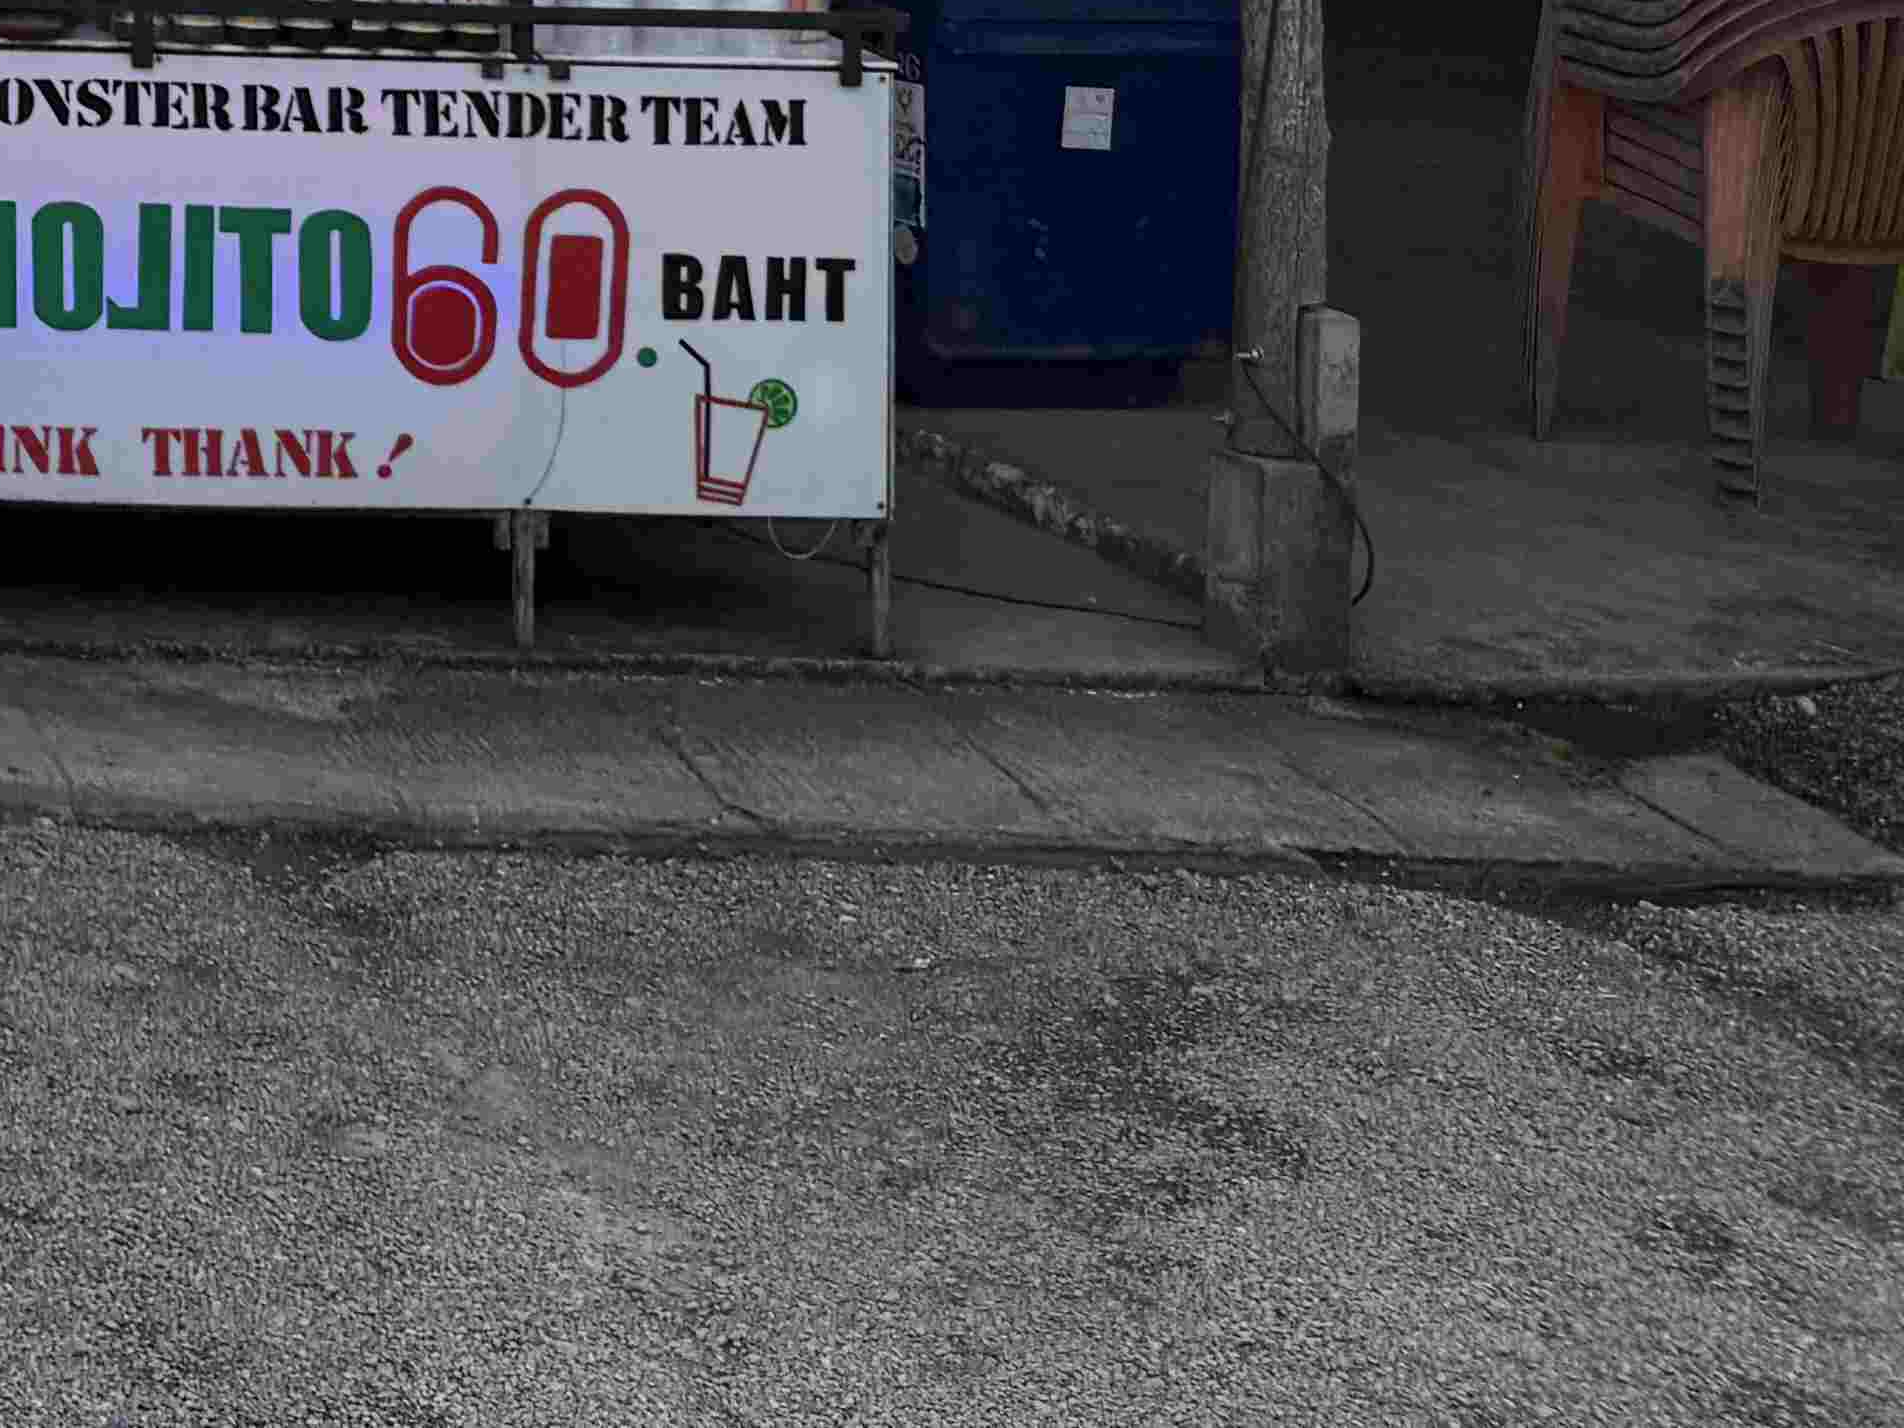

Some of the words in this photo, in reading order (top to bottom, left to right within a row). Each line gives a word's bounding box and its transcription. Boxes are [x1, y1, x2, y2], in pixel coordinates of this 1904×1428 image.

[241, 83, 369, 135] BAR
[381, 88, 630, 142] TENDER
[640, 95, 808, 146] TEAM
[661, 251, 857, 323] BAHT
